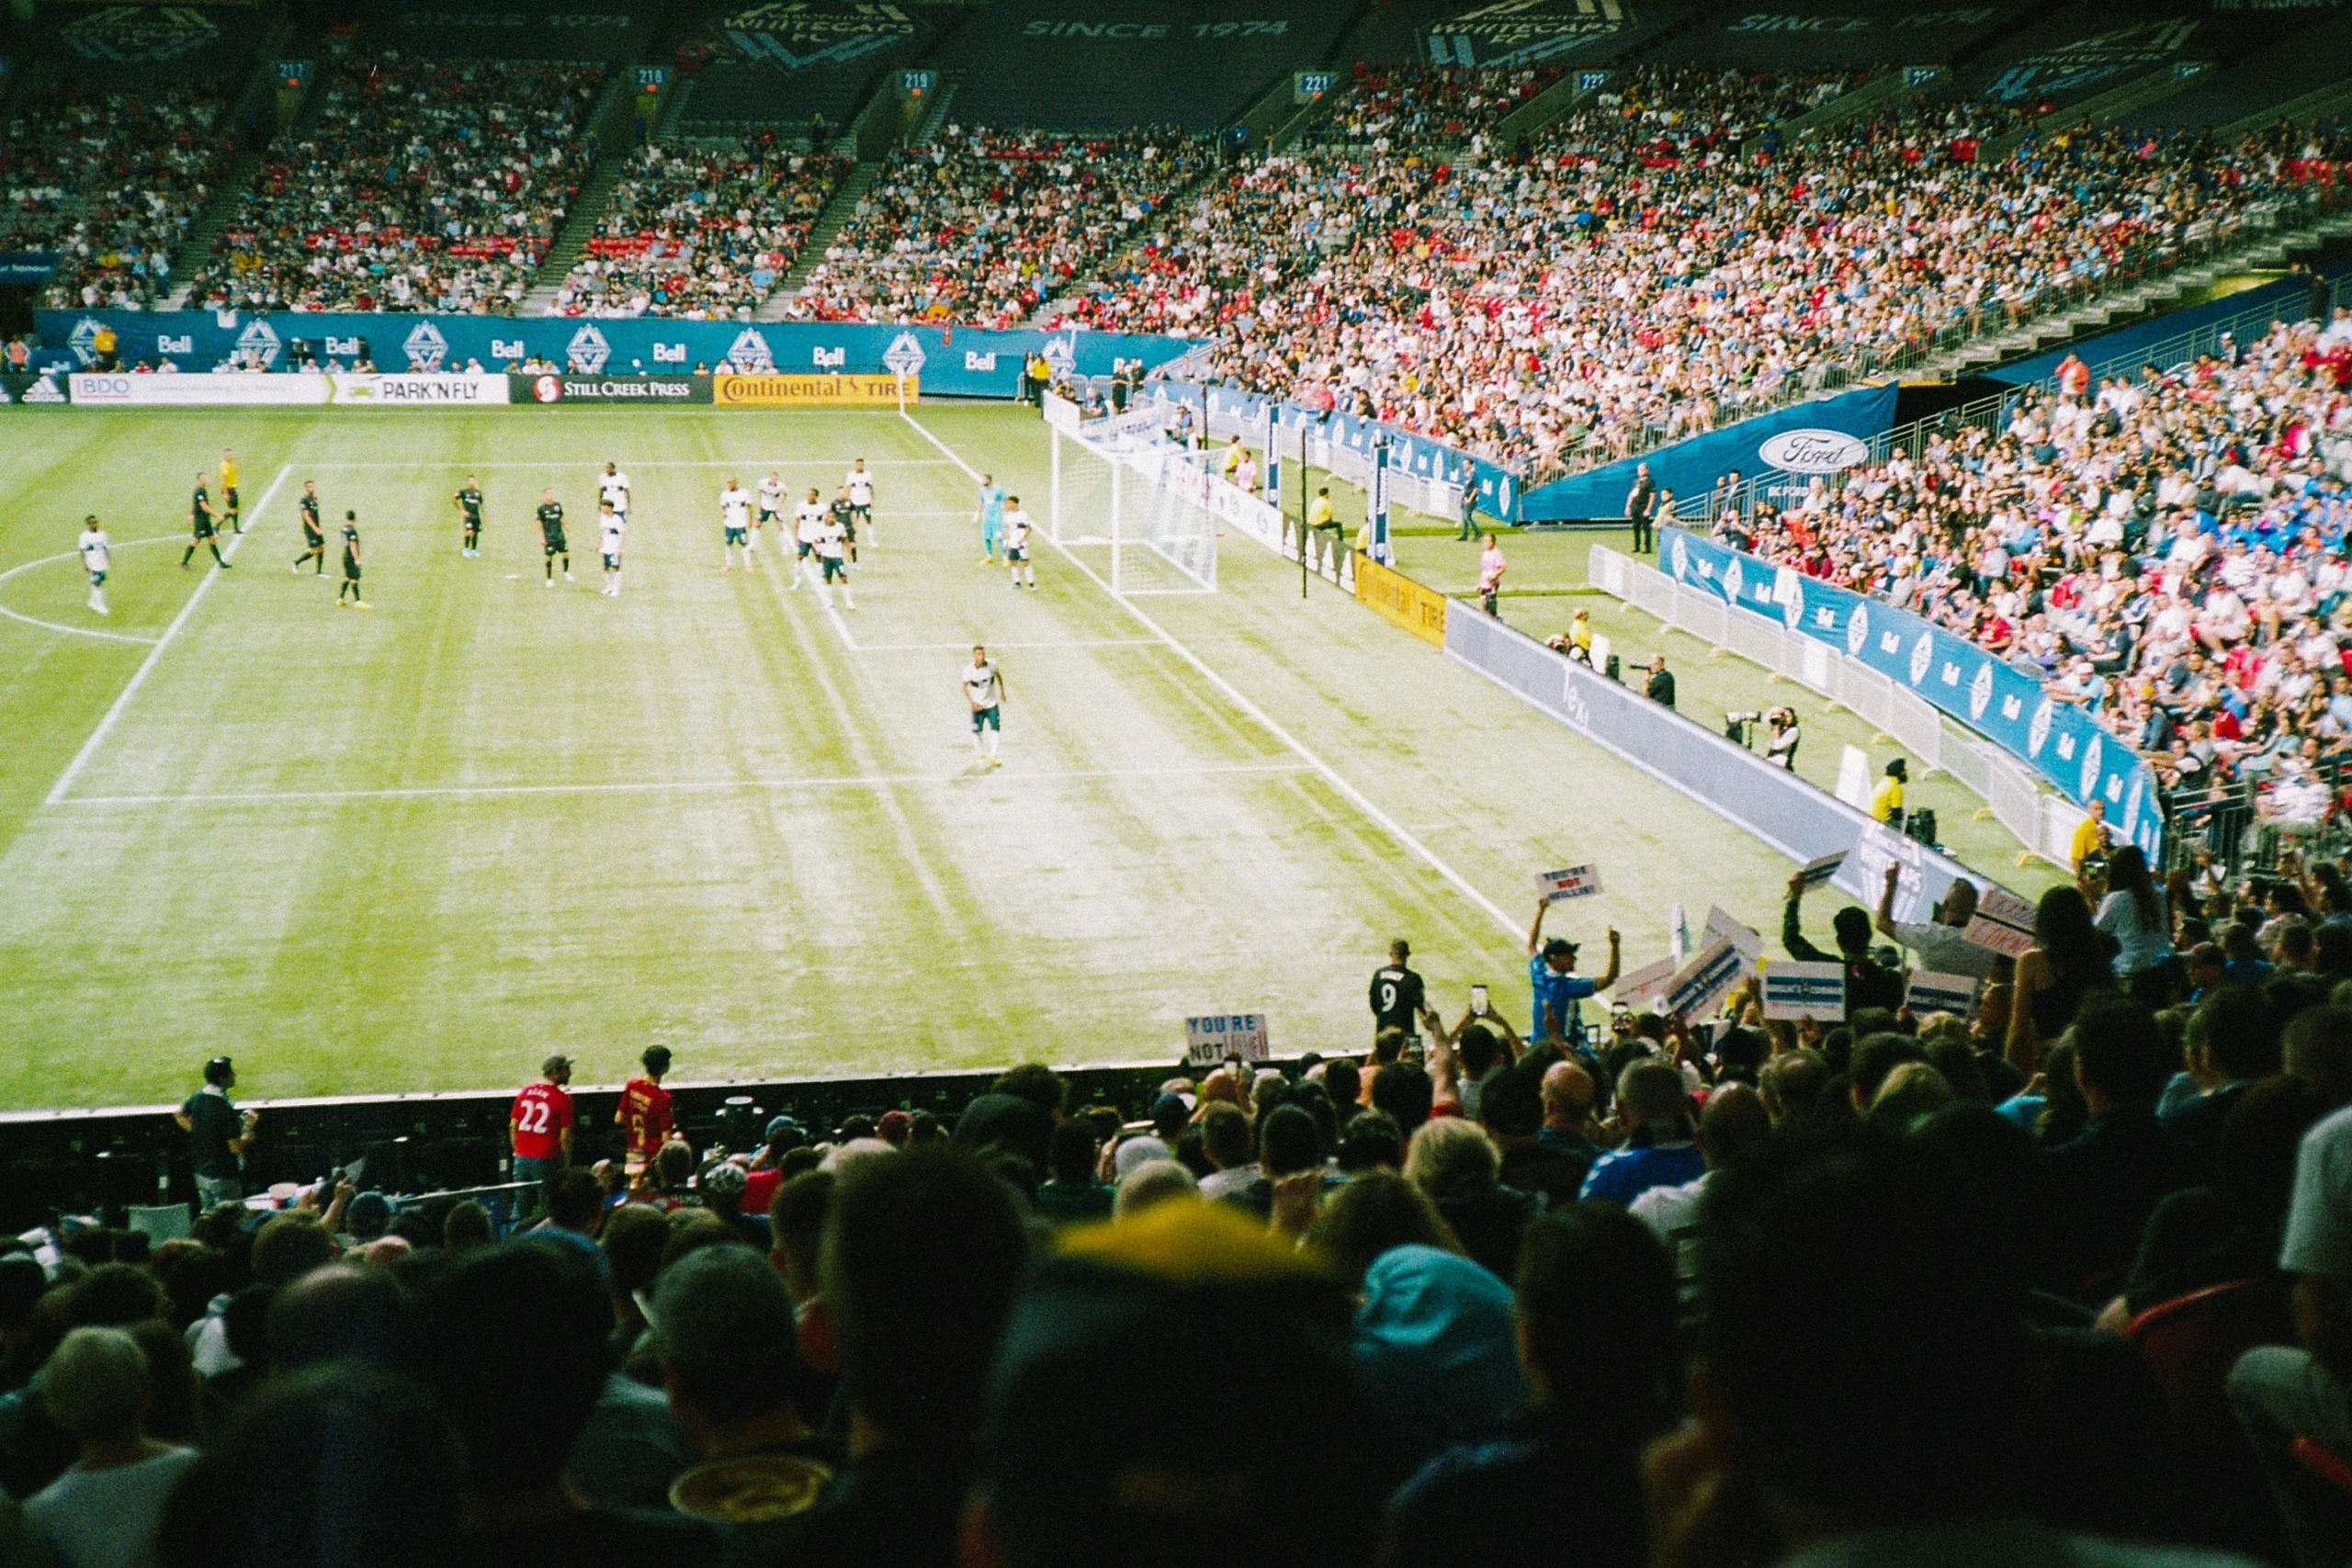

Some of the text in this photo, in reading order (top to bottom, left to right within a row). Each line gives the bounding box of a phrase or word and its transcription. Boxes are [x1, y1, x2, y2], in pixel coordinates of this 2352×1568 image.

[723, 17, 913, 33] WHITECAPS
[1023, 20, 1288, 38] SINCE 1974
[1430, 21, 1621, 34] WHITECAPS
[904, 73, 929, 89] 219
[1305, 75, 1329, 92] 221
[158, 334, 191, 354] Bell
[326, 335, 359, 355] Bell
[492, 340, 525, 358] Bell
[652, 344, 686, 362] Bell
[812, 346, 845, 366] Bell
[965, 351, 997, 371] Bell
[83, 378, 130, 394] BDO
[452, 381, 479, 400] FLY
[563, 380, 691, 397] STILL CREEK PRESS
[722, 377, 910, 401] Continental TIRE
[1782, 436, 1846, 464] Ford
[1381, 982, 1397, 1013] 9
[517, 1099, 550, 1134] 22
